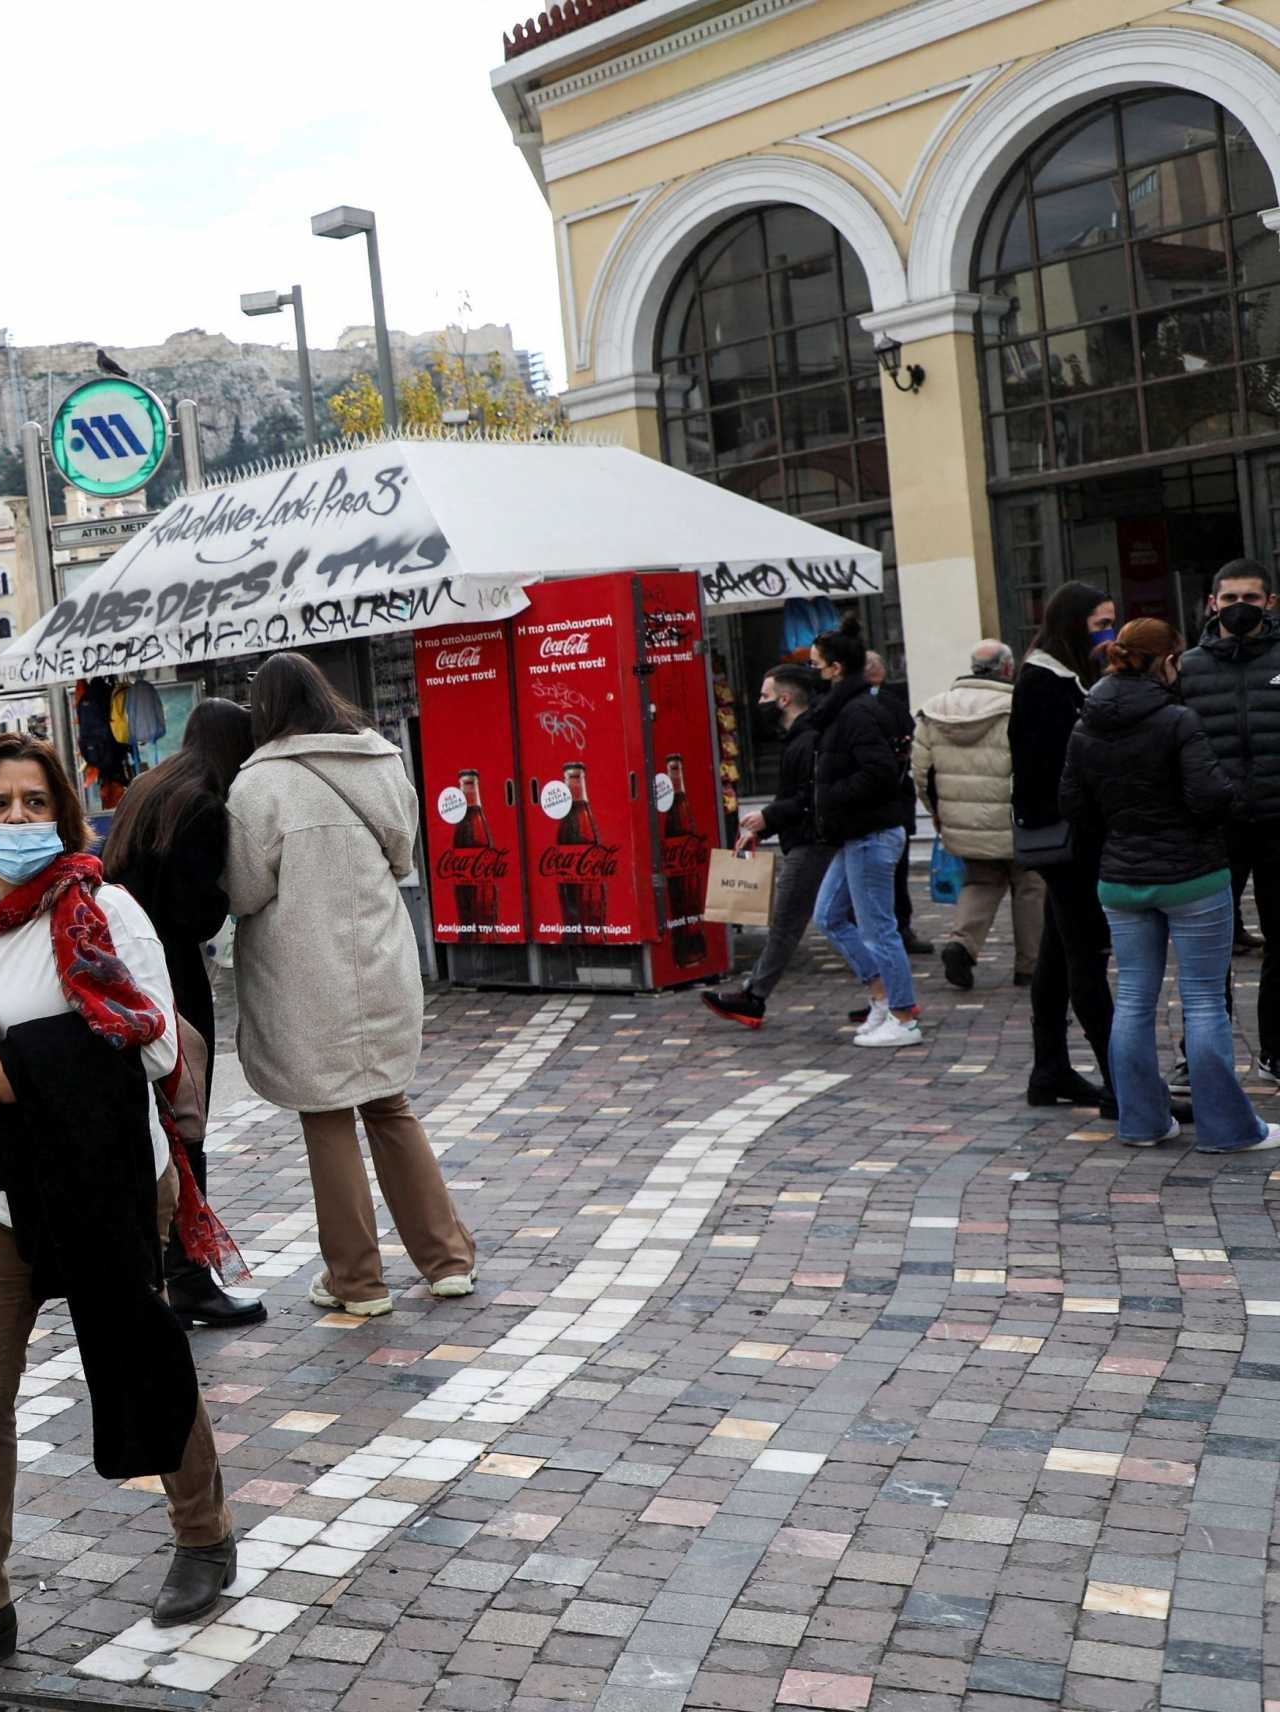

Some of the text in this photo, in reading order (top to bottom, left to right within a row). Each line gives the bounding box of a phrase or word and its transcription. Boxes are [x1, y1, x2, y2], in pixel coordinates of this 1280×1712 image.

[528, 624, 545, 634] πιο
[546, 614, 613, 632] απολαυστική
[441, 628, 503, 645] απολαυστική
[529, 656, 606, 675] που έγινε ποτέ!
[426, 668, 497, 686] που έγινε ποτέ!
[437, 922, 519, 935] Δοκίμασέ την τώρα!
[539, 923, 631, 936] Δοκίμασέ την τώρα!
